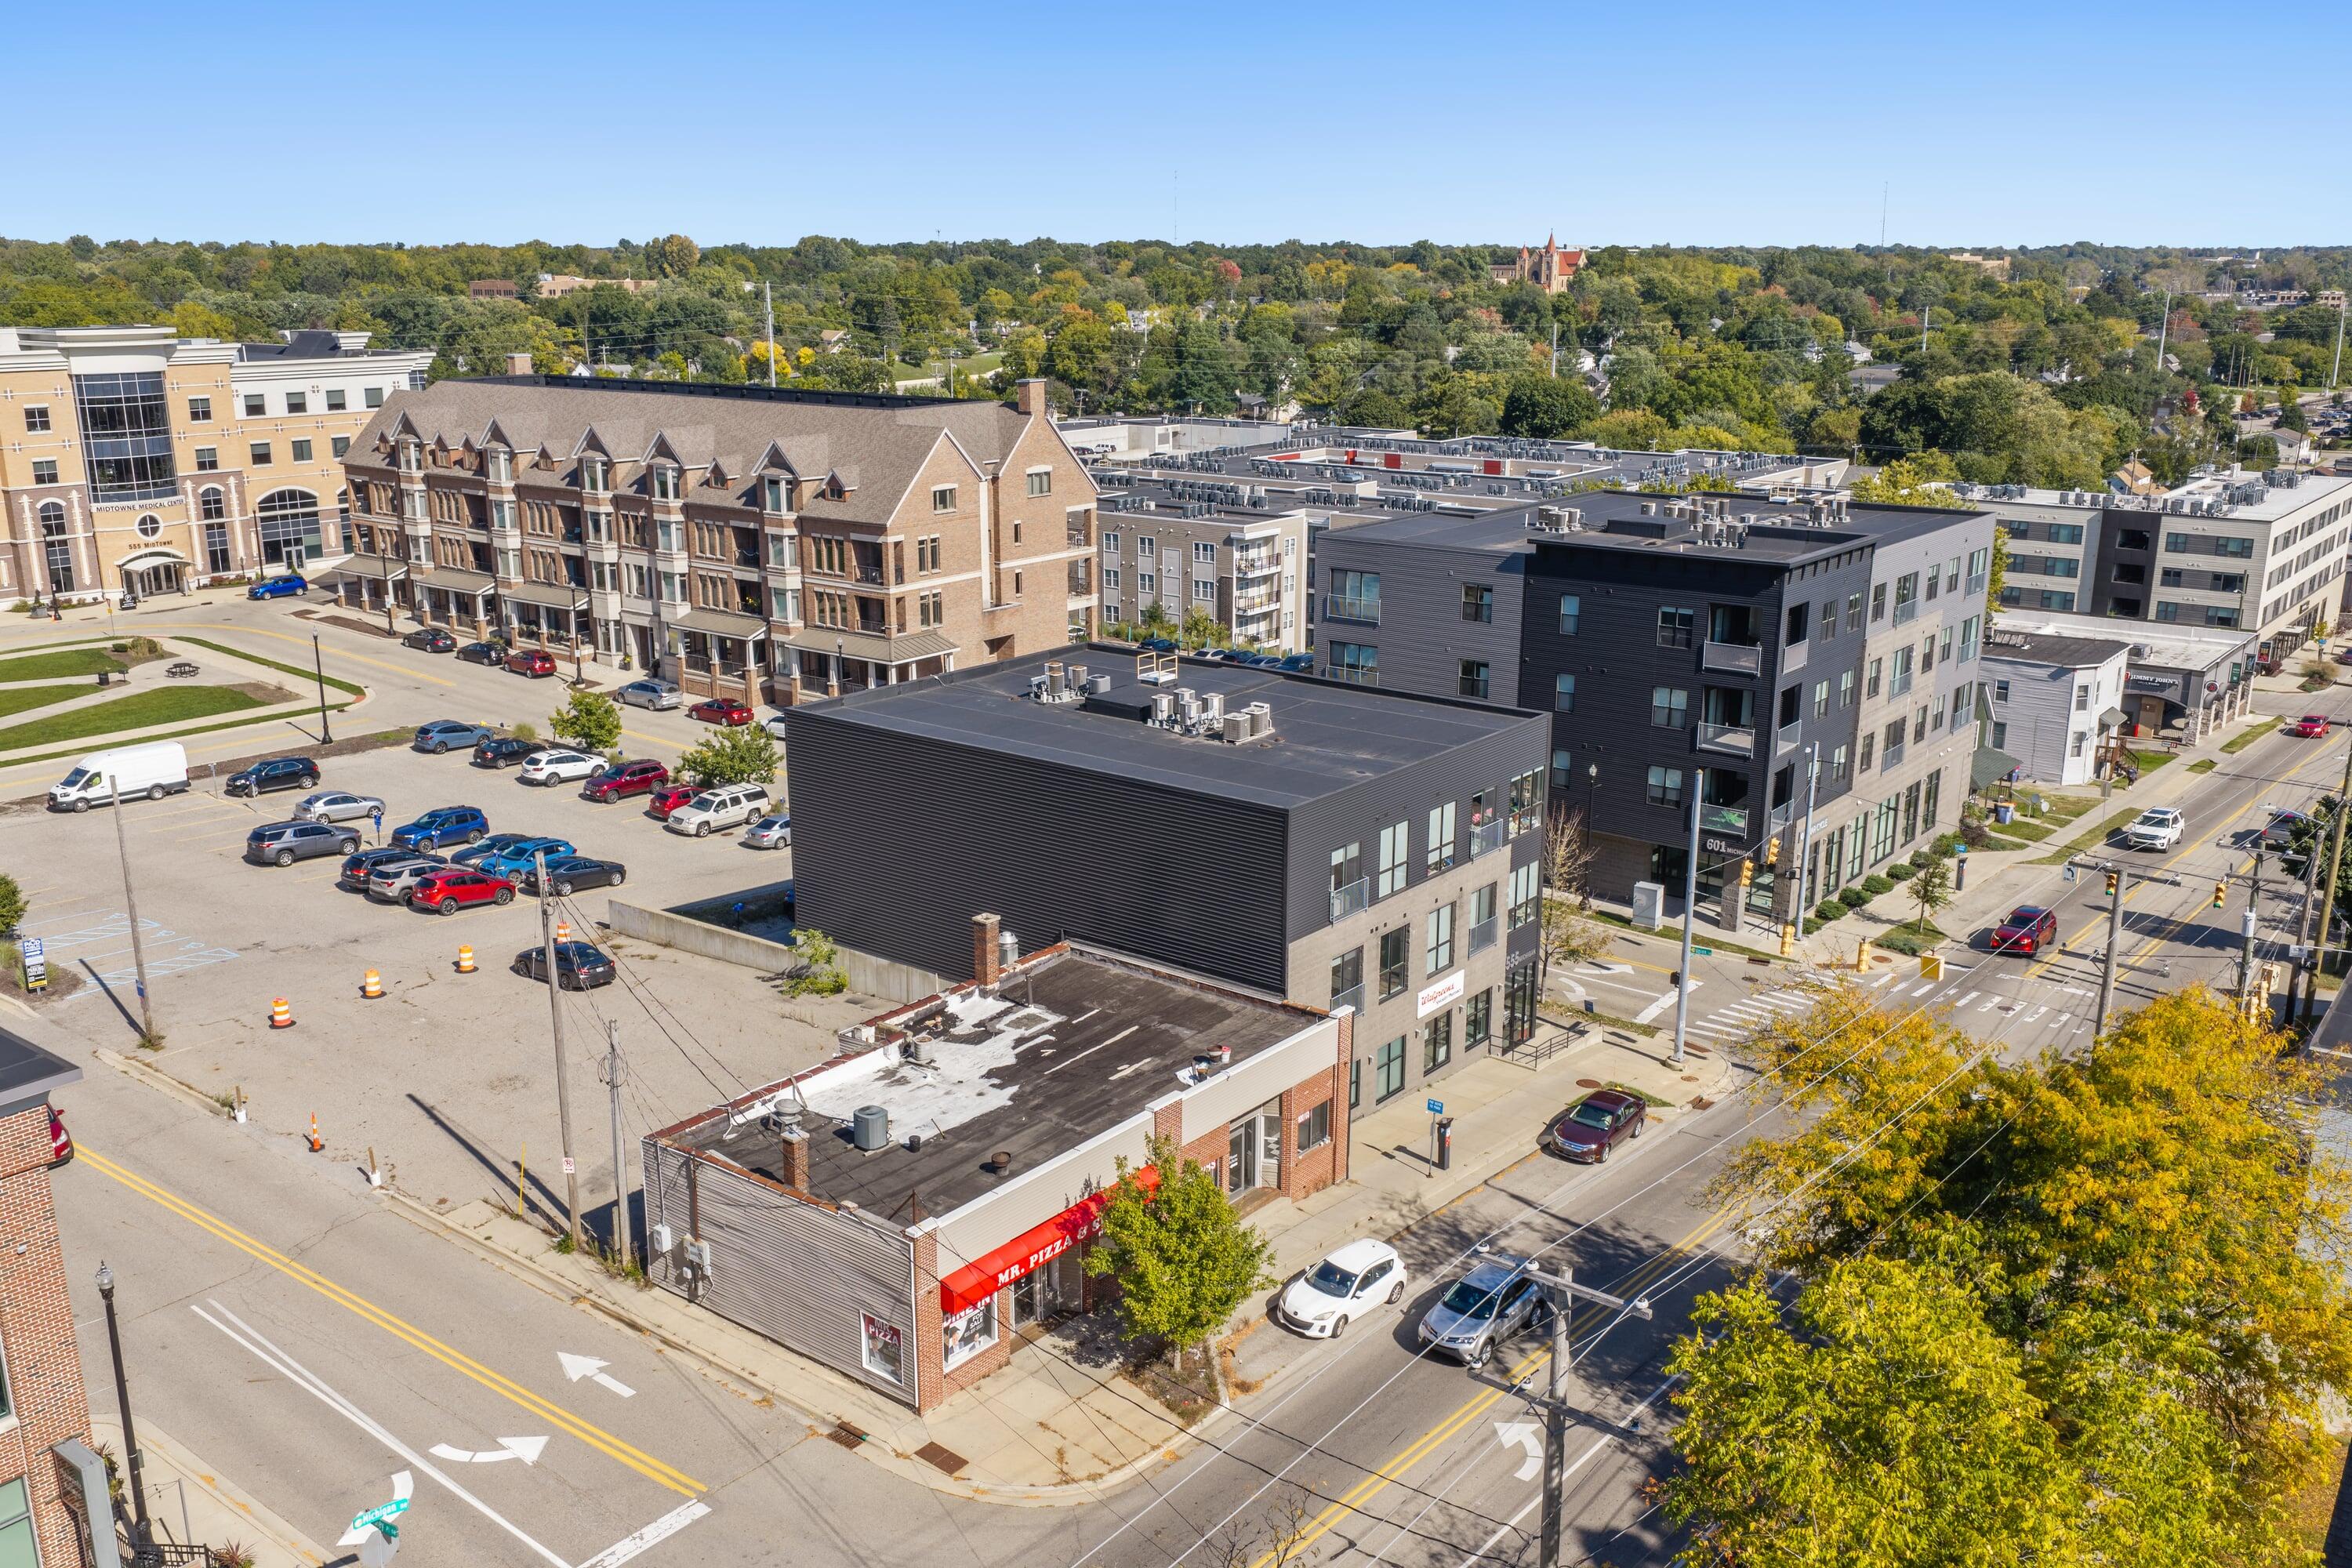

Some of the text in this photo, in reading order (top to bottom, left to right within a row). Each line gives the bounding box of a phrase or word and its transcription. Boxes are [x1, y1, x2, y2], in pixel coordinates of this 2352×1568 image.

[96, 504, 136, 513] MIDTOWNE
[167, 499, 183, 507] CENTER
[1706, 838, 1754, 858] 601 MICHIGAN
[1505, 951, 1519, 971] 555
[1421, 983, 1454, 1006] Walgreens
[997, 1225, 1088, 1287] MR. PIZZA &
[943, 1295, 991, 1328] DINE IN
[972, 1311, 983, 1322] FOR
[874, 1318, 893, 1334] MR.
[970, 1317, 984, 1330] SALE
[869, 1323, 899, 1347] PIZZA
[361, 1503, 397, 1524] Michigan
